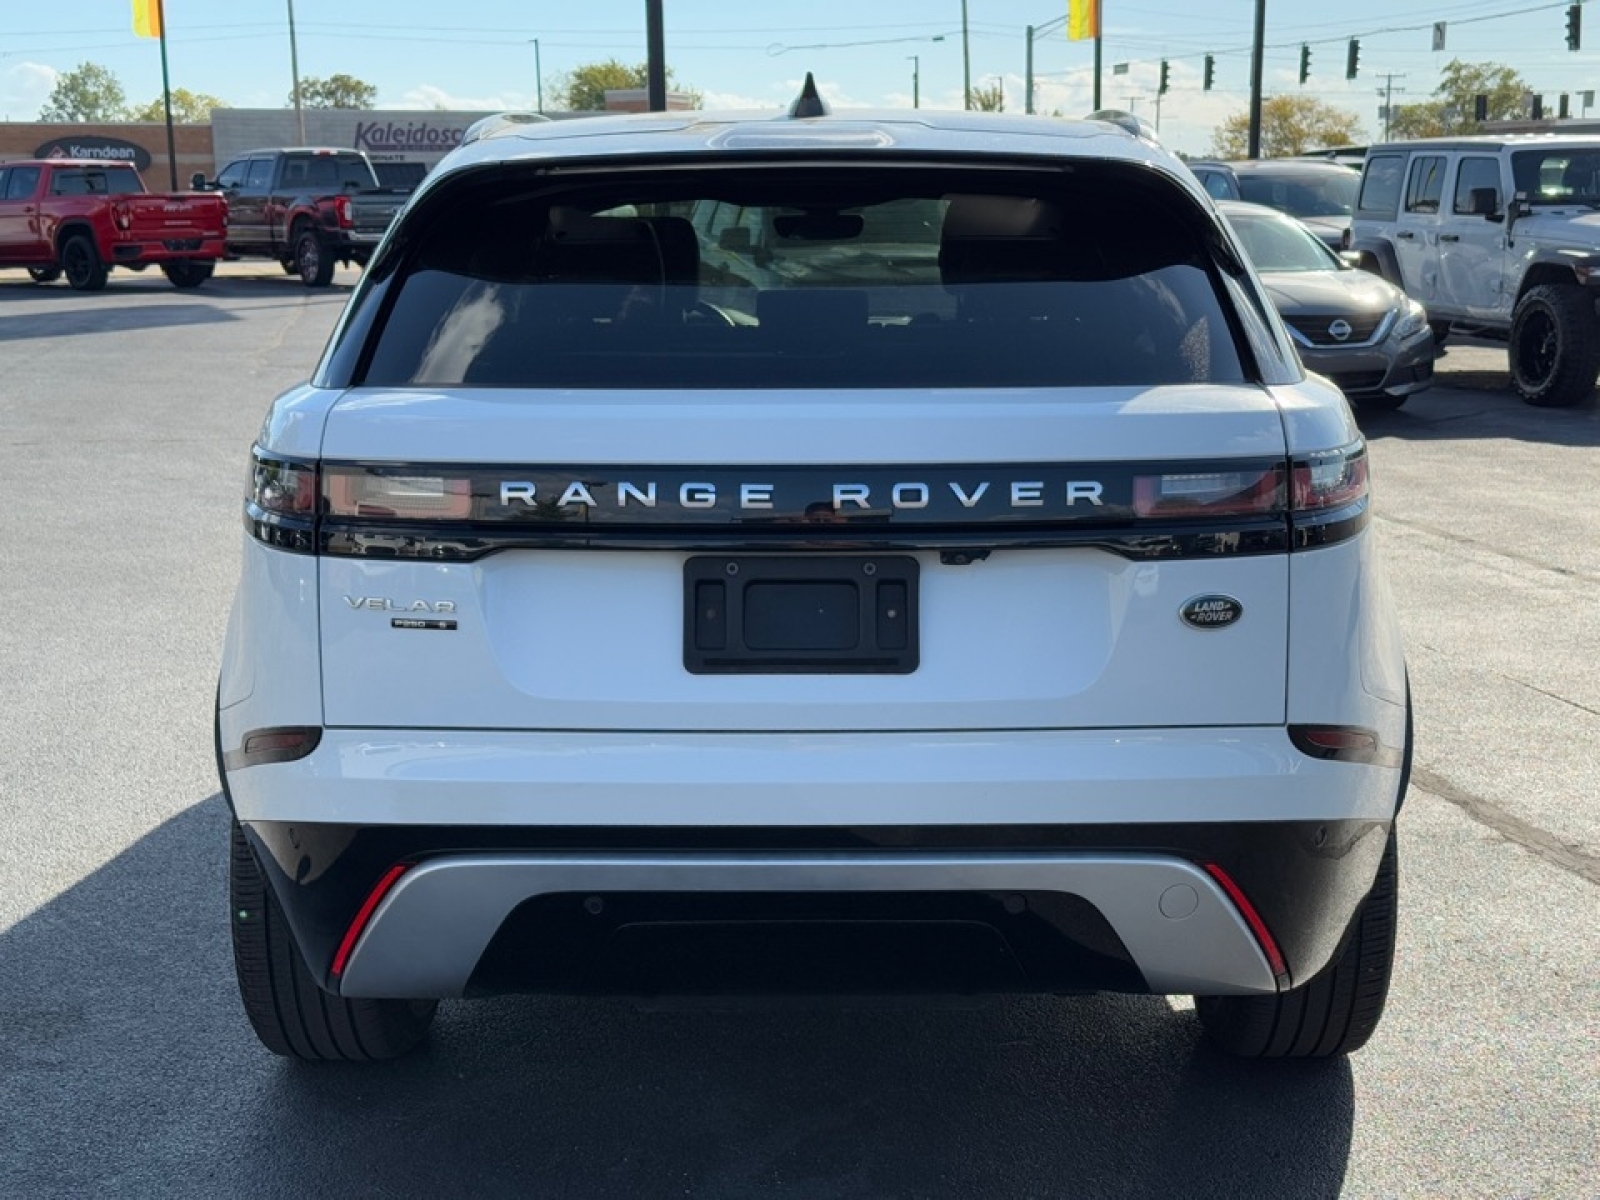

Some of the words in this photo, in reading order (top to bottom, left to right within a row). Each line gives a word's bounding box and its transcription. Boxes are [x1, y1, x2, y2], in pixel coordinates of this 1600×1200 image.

[70, 145, 135, 158] Karndean
[500, 481, 774, 509] RANGE
[832, 481, 1104, 509] ROVER
[343, 595, 457, 613] VELAR
[1194, 601, 1224, 613] LAND
[1196, 611, 1233, 622] ROVER
